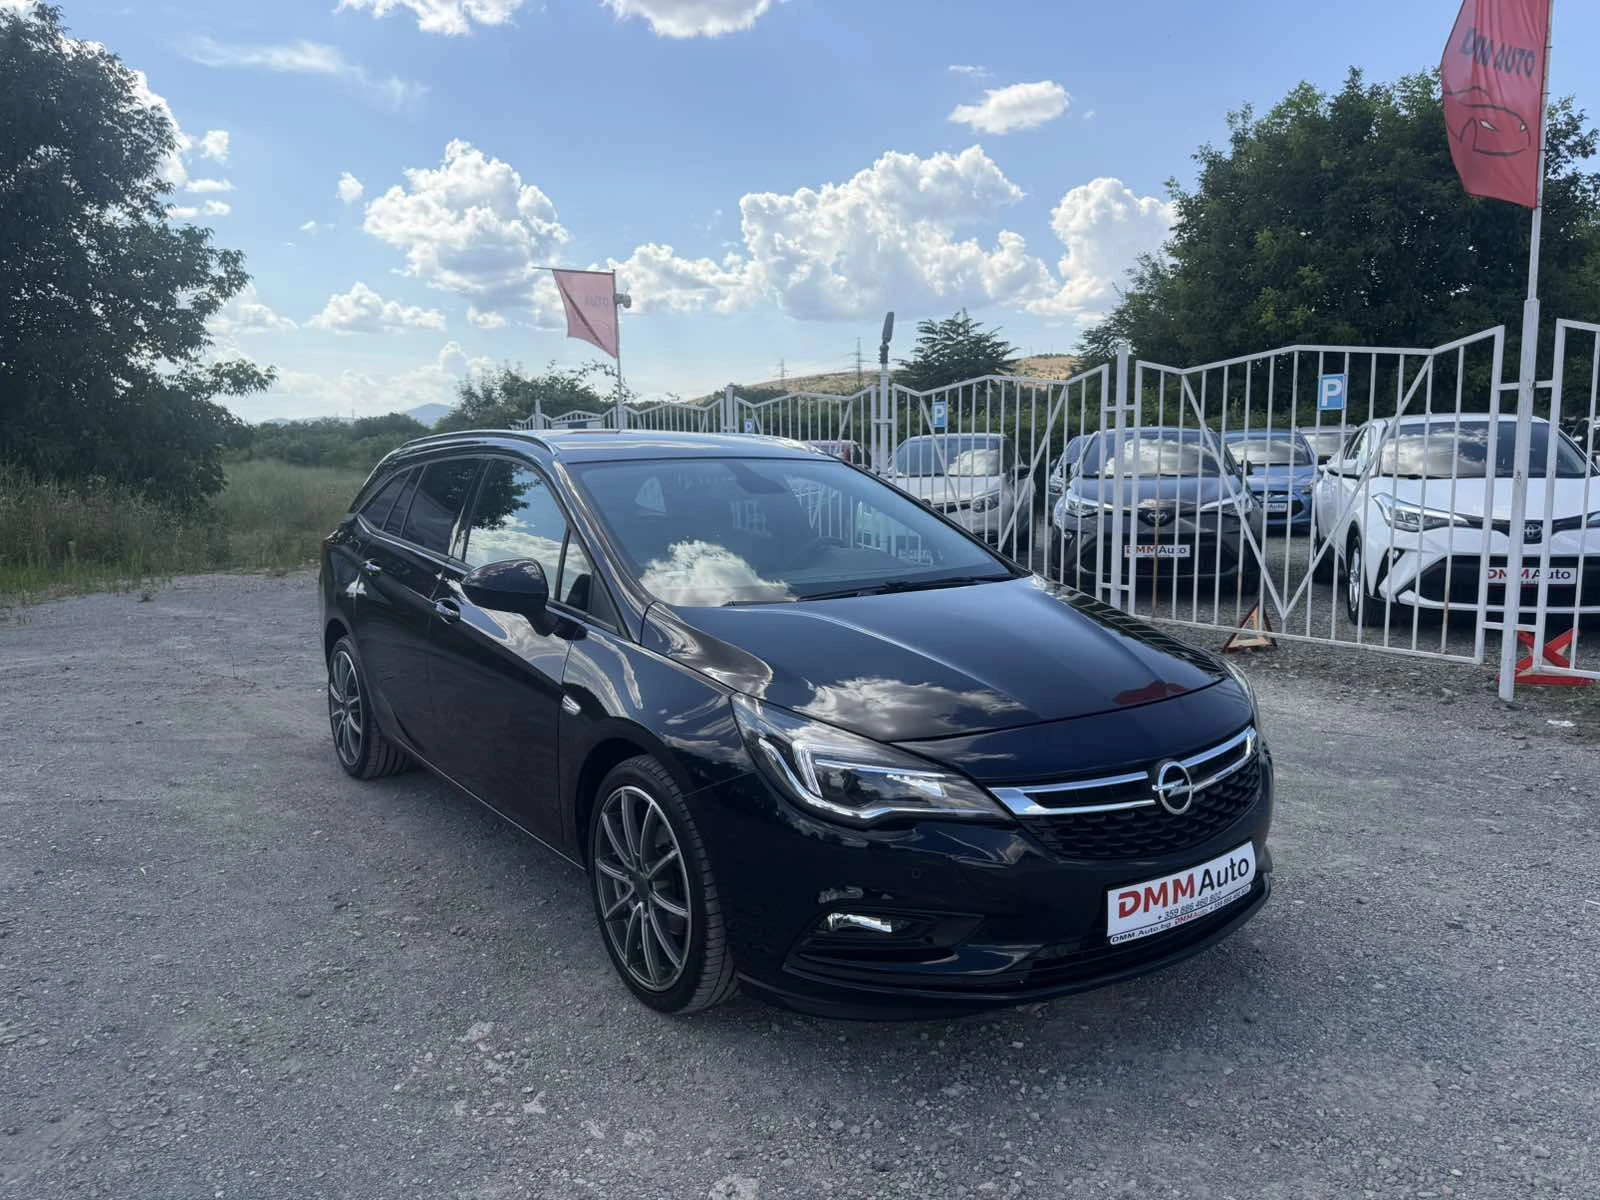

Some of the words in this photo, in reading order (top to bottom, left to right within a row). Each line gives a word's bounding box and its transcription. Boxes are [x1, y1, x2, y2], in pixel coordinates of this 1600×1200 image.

[1494, 41, 1536, 78] AUTO
[1321, 379, 1343, 407] P
[1126, 545, 1186, 554] MMAuo
[1118, 857, 1249, 919] DMMAuto
[1164, 908, 1179, 919] 359
